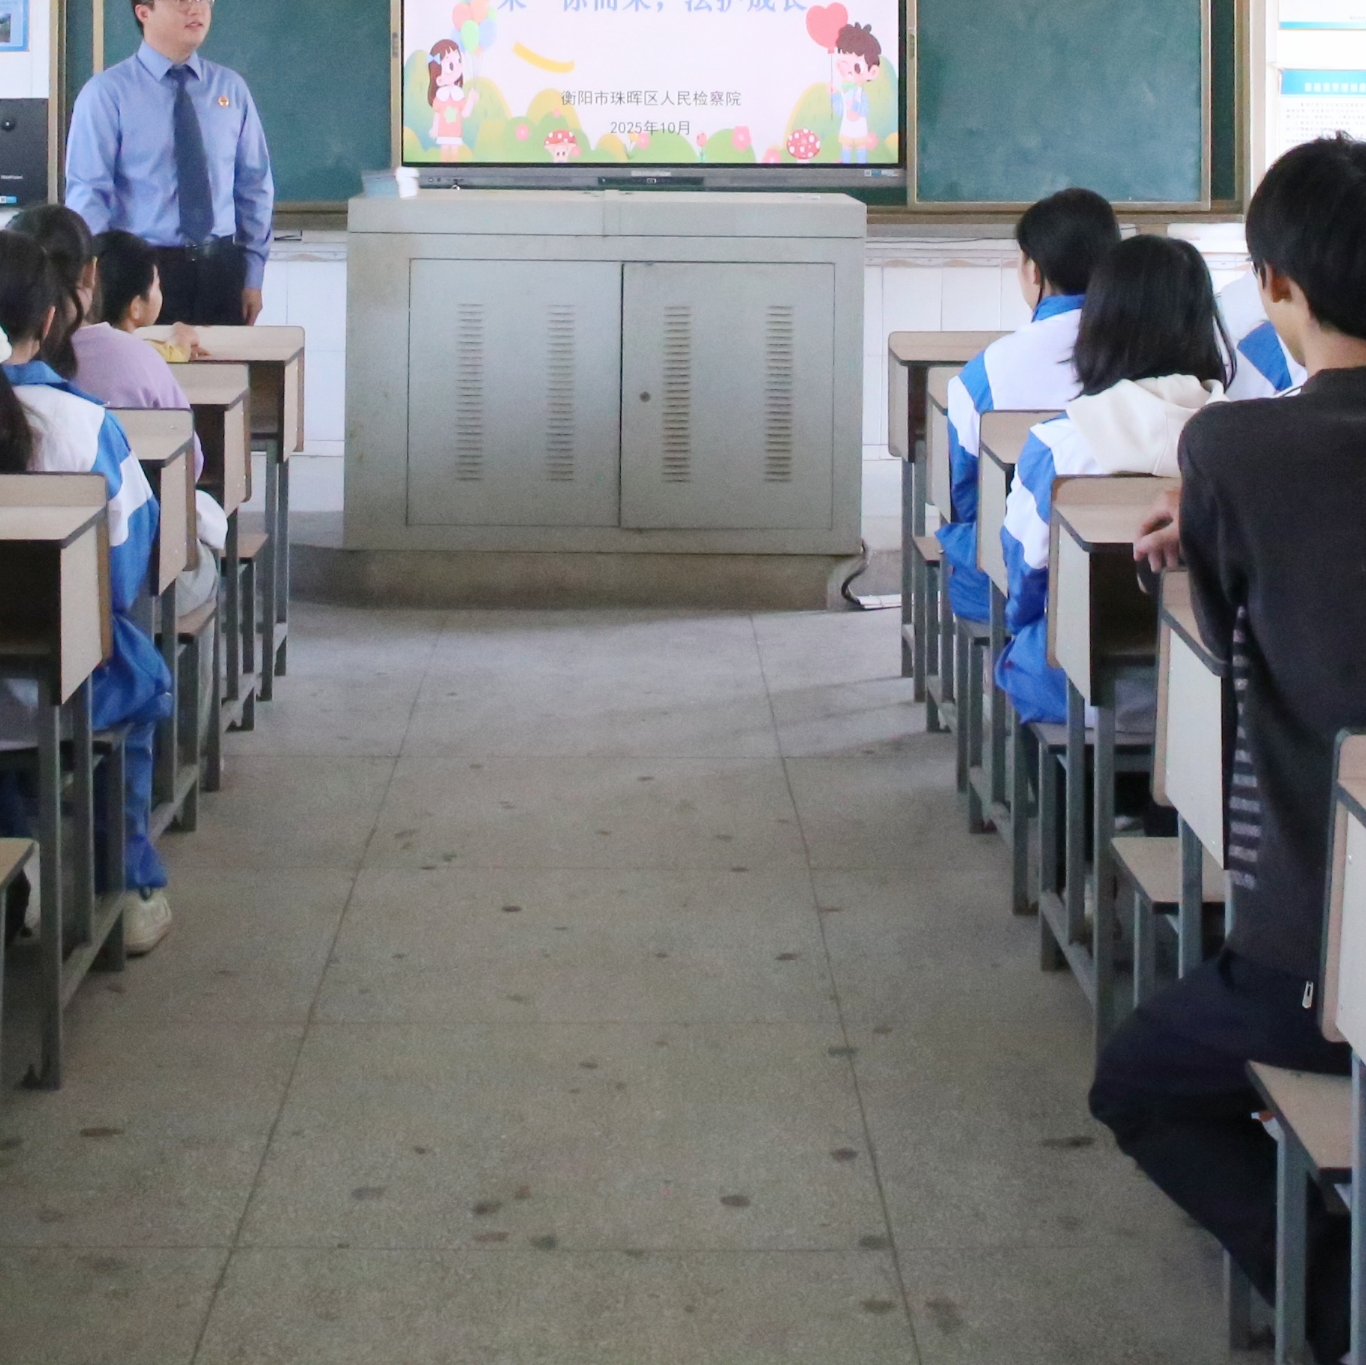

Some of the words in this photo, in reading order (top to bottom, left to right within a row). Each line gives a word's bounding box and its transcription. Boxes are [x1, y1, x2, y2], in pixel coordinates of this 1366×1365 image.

[561, 90, 742, 106] 衡阳市珠晖区人民检察院
[610, 120, 690, 135] 2025年10月
